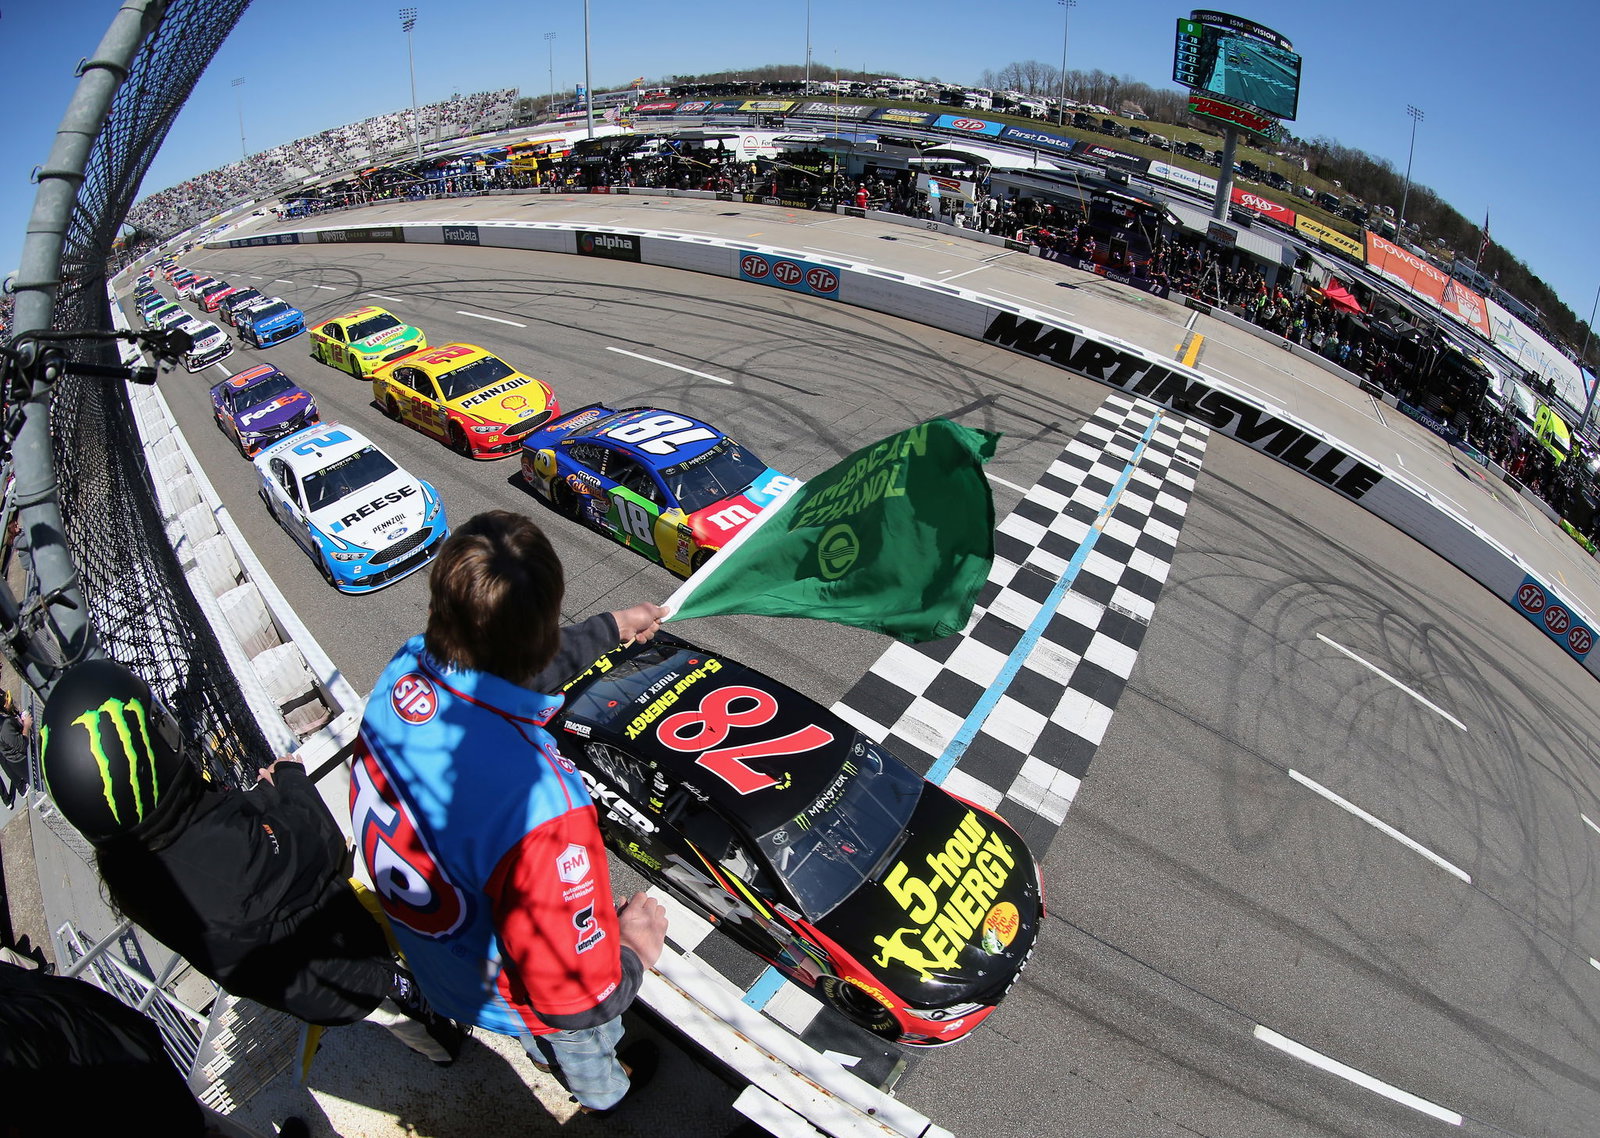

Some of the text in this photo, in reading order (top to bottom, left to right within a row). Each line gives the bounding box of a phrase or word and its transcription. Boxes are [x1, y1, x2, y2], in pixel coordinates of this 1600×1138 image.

[1190, 36, 1198, 44] 78
[1253, 26, 1276, 41] VISION
[808, 102, 863, 114] Bassett
[955, 120, 981, 130] STP
[1172, 171, 1216, 190] ClickList
[926, 222, 938, 230] 23
[594, 234, 633, 249] alpha
[743, 257, 767, 275] STP
[775, 263, 800, 281] STP
[1079, 260, 1106, 276] FedEx
[1106, 271, 1130, 284] Ground
[809, 270, 835, 288] STP
[365, 326, 404, 347] LIBMAN
[1282, 341, 1292, 352] 21
[332, 343, 343, 363] 12
[460, 377, 532, 410] PENNZOIL
[240, 392, 308, 426] FedEx
[984, 311, 1385, 501] MARTINSVILLE
[606, 414, 717, 455] 18
[1421, 415, 1446, 435] motors
[292, 430, 352, 456] 2
[488, 435, 499, 443] 22
[341, 484, 417, 529] REESE
[372, 513, 407, 535] PENNZOIL
[612, 494, 655, 546] 18
[388, 544, 425, 568] FUSION
[353, 565, 362, 574] 2
[1520, 587, 1543, 609] STP
[1545, 610, 1567, 630] STP
[1569, 631, 1590, 650] STP
[394, 679, 432, 717] STP
[634, 671, 680, 704] TRUEX JR.
[626, 659, 723, 740] 5-hour ENERGY
[564, 720, 592, 735] TRACKER
[656, 685, 834, 796] 78
[807, 773, 848, 817] MONSTER
[825, 788, 846, 813] ENERGY
[883, 809, 987, 925] 5-hour
[921, 831, 1016, 969] ENERGY
[987, 907, 1003, 929] Bass
[1002, 913, 1018, 938] Shops
[845, 976, 895, 1009] GOODYEAR
